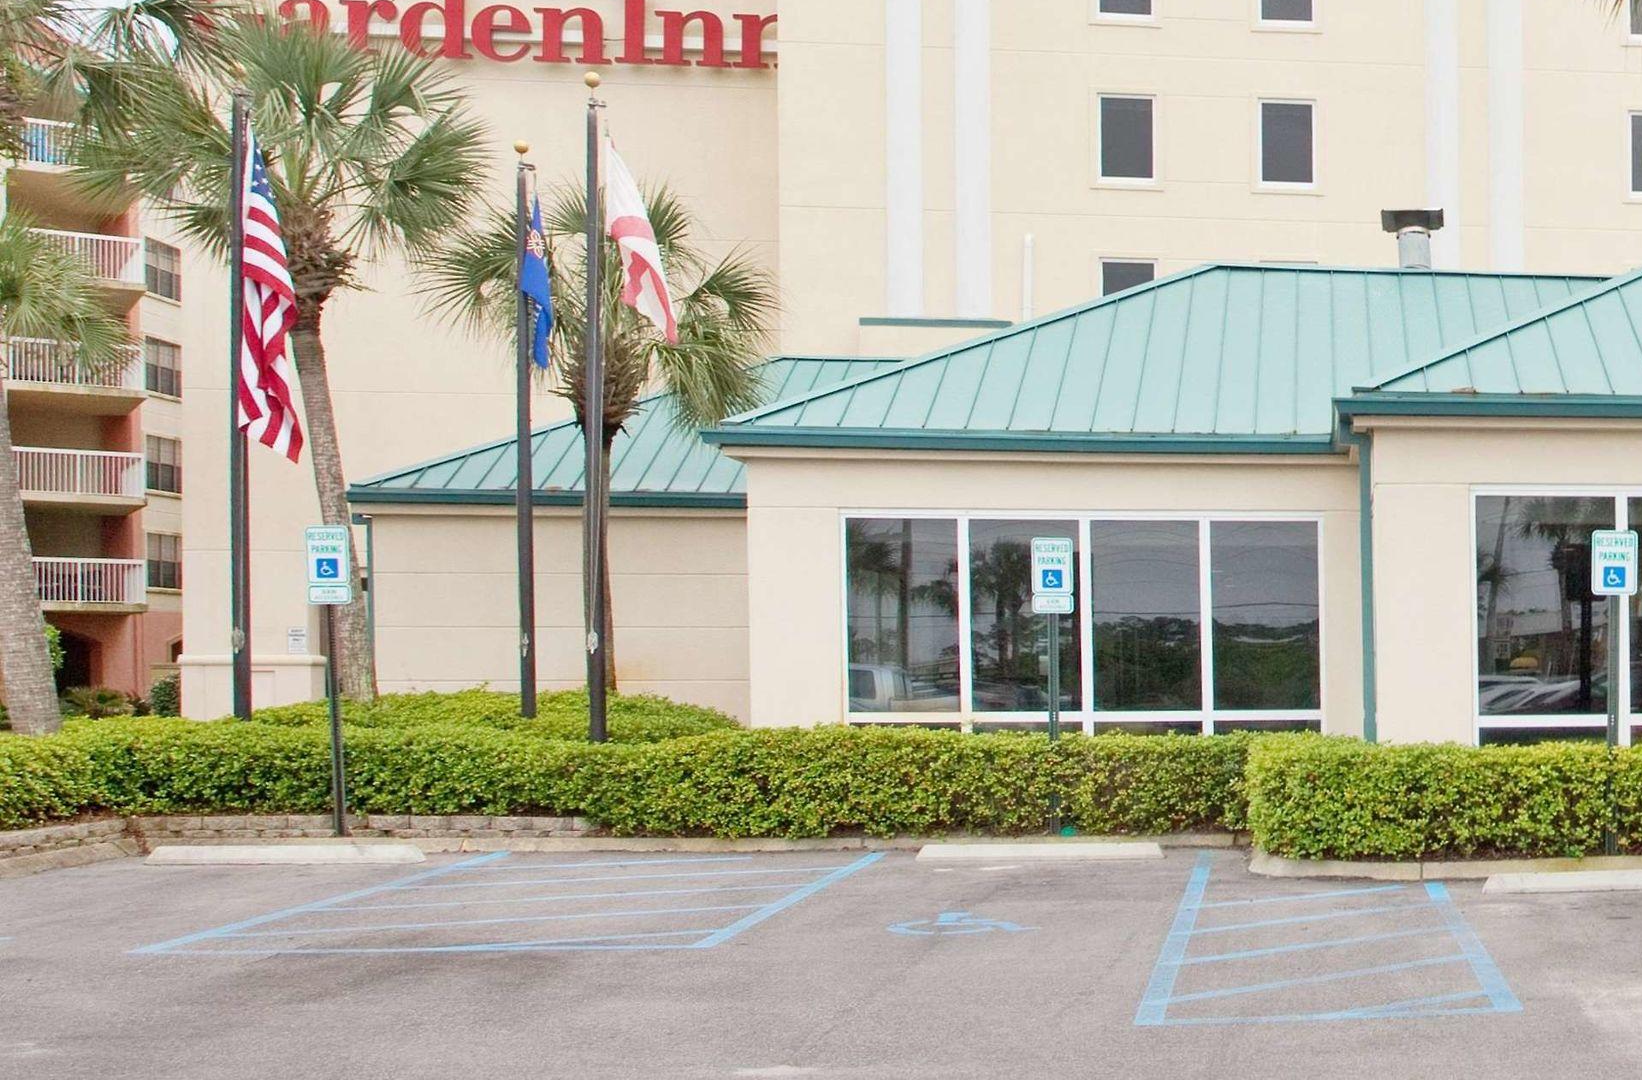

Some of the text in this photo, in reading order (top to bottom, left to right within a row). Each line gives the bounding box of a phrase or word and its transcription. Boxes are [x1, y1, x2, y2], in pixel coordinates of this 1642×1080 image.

[1596, 537, 1634, 547] RESERVED
[1035, 543, 1068, 553] RESERVED
[1037, 556, 1066, 565] PARKING
[1599, 551, 1631, 561] PARKING
